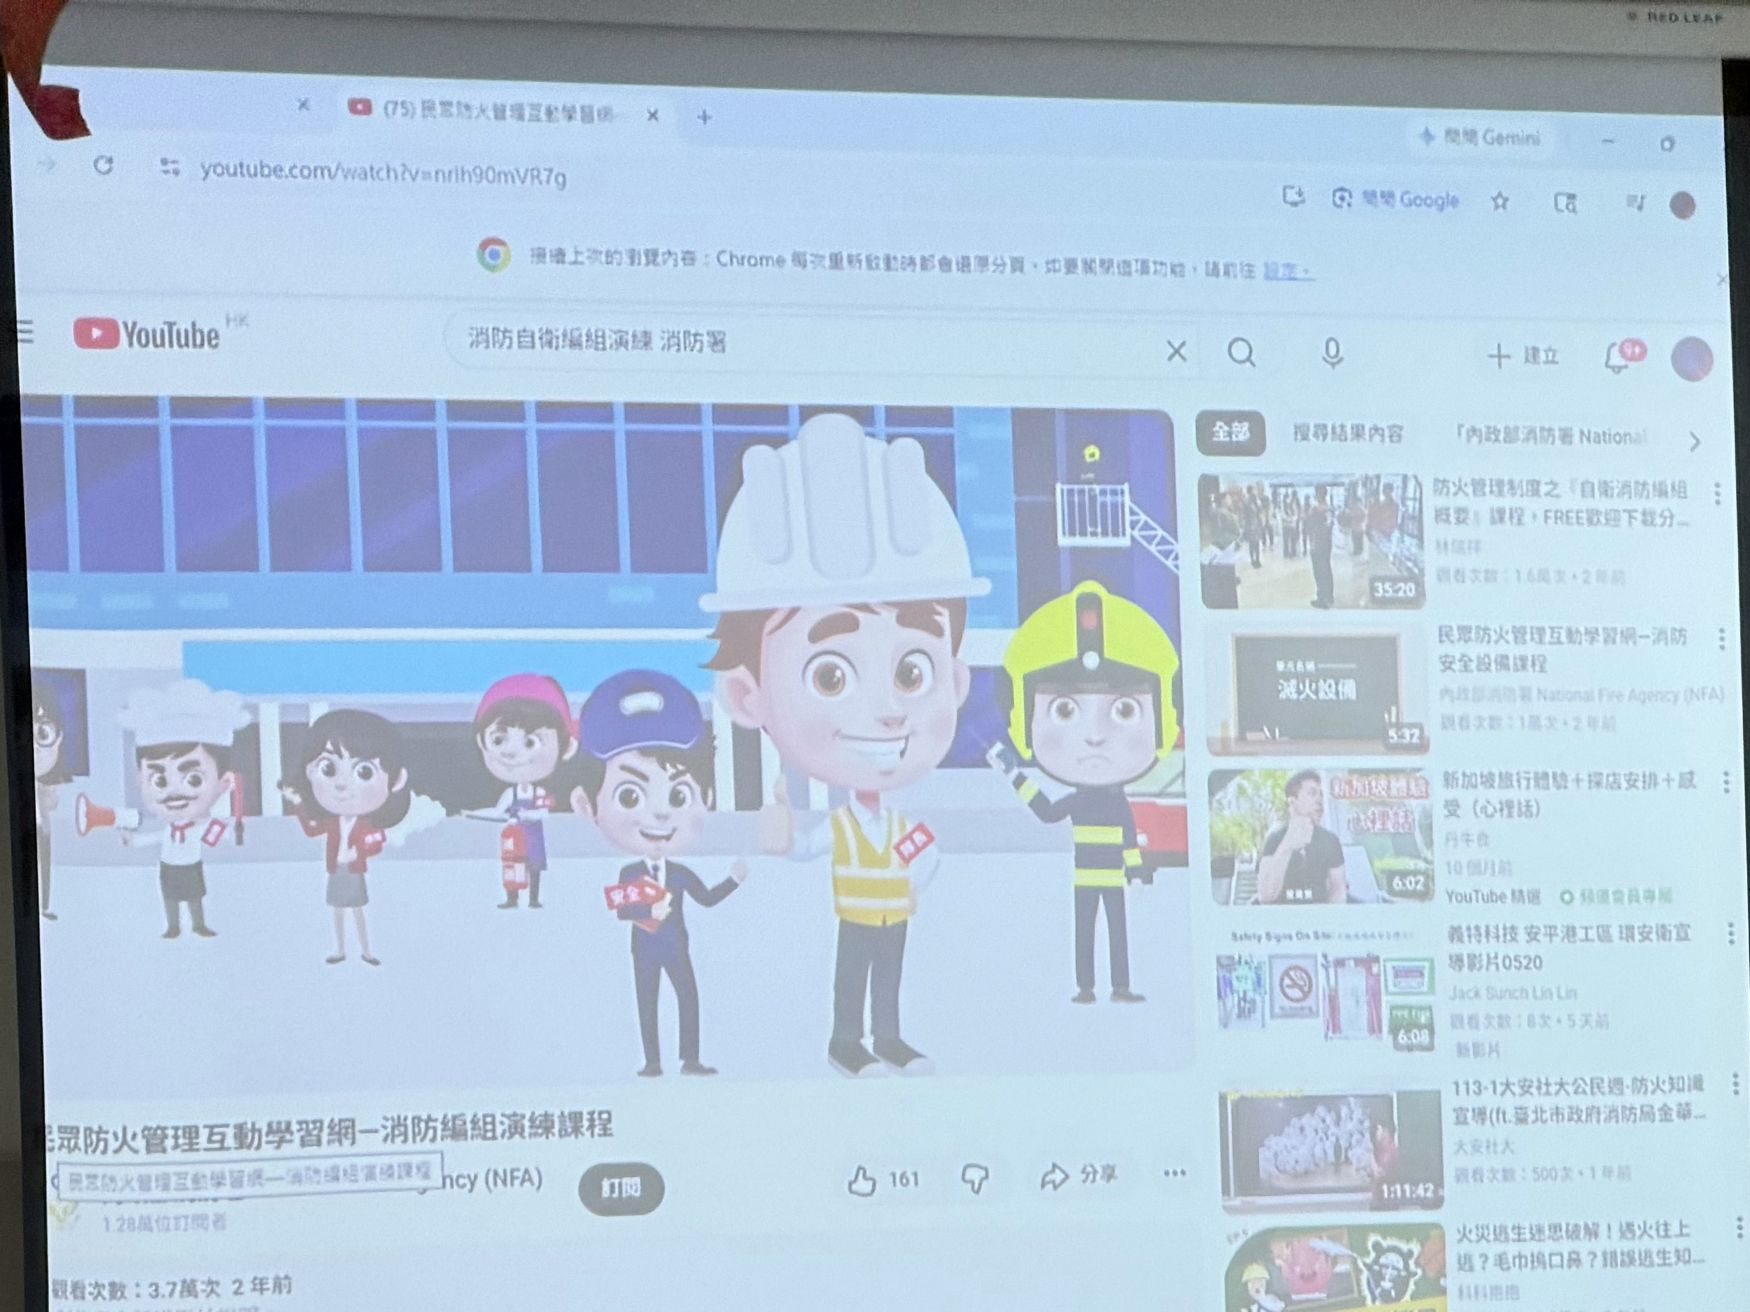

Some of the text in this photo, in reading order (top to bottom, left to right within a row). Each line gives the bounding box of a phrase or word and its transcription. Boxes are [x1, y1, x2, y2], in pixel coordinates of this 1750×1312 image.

[383, 99, 417, 119] (75)
[1482, 127, 1541, 148] Gemini
[1399, 190, 1460, 213] Google
[121, 320, 220, 350] YouTube
[468, 326, 727, 354] 消防自衛編組演練 消防署
[1523, 345, 1560, 365] 建立
[1212, 421, 1251, 443] 全部
[1293, 422, 1405, 444] 搜尋結果內容
[1373, 580, 1417, 598] 35:20
[1439, 652, 1548, 674] 安全設備課程
[1278, 677, 1358, 701] 滅火設備
[1628, 686, 1681, 706] Agency
[1684, 685, 1727, 705] (NFA)
[1388, 727, 1420, 744] 5:32
[1445, 860, 1462, 877] 10
[1392, 875, 1425, 890] 6:02
[1445, 888, 1507, 905] YouTube
[1448, 952, 1544, 973] 導影片0520
[1450, 985, 1482, 1001] Jack
[484, 1166, 543, 1192] (NFA)
[889, 1169, 920, 1188] 161
[1079, 1162, 1118, 1184] 分享
[601, 1176, 642, 1198] 訂閱
[1381, 1183, 1435, 1199] 1:11:42
[231, 1277, 244, 1297] 2
[249, 1275, 293, 1297] 年前
